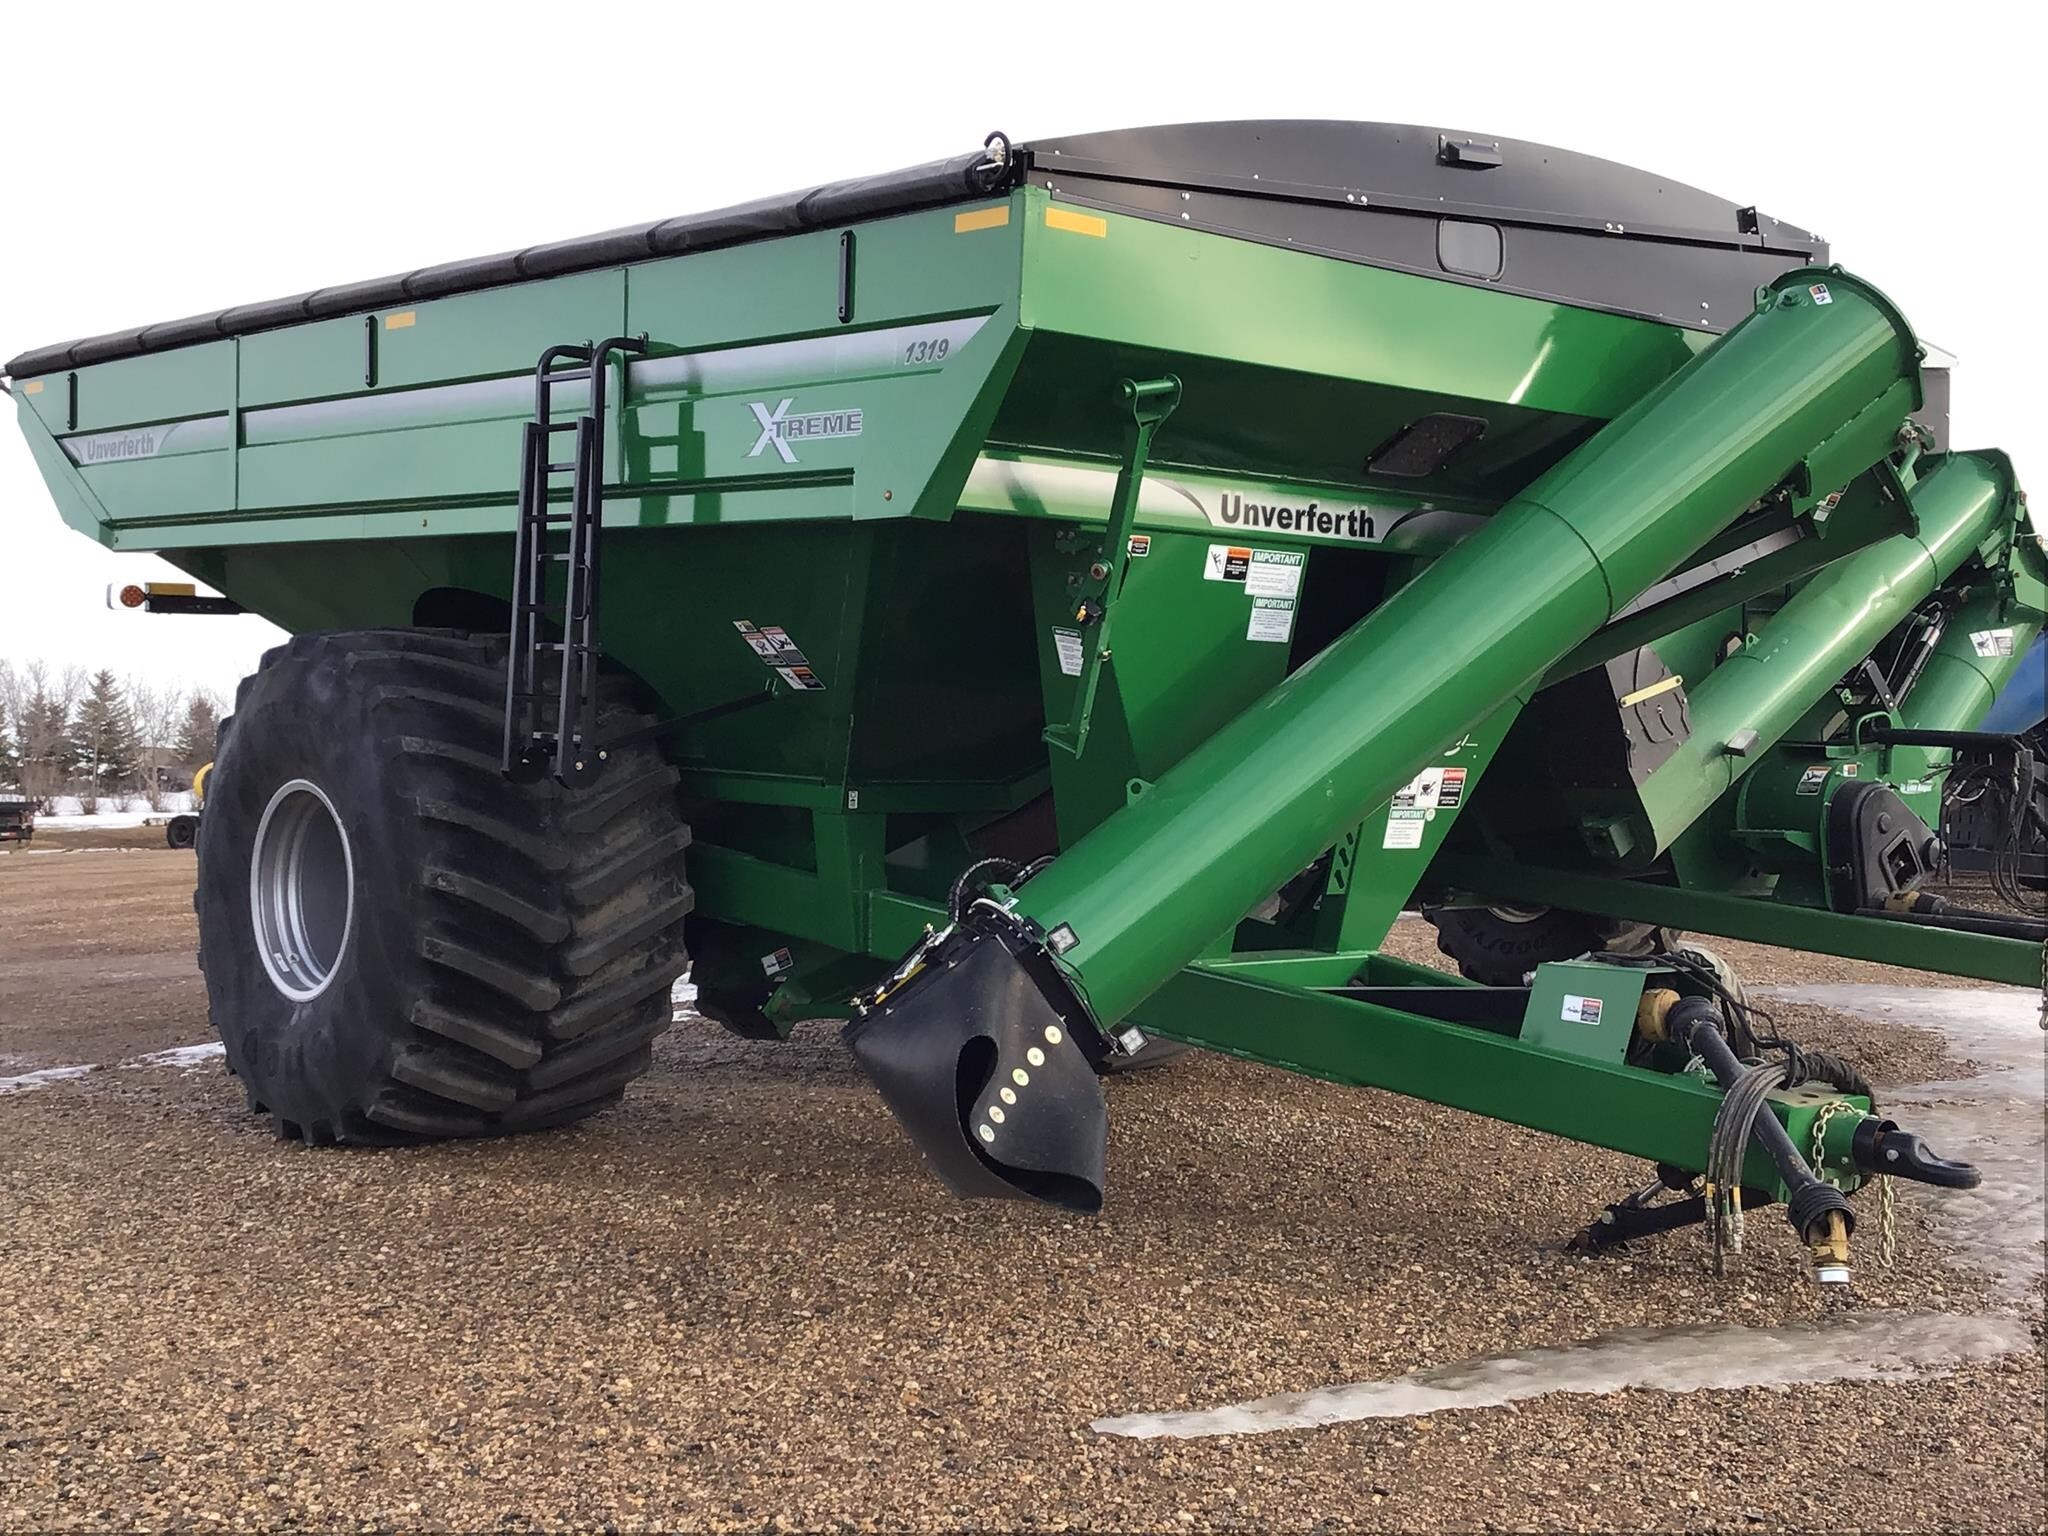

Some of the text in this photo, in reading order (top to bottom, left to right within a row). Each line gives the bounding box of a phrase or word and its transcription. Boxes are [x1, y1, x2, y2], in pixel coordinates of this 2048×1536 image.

[904, 338, 950, 363] 1319
[87, 433, 154, 460] Unverferth
[1221, 494, 1375, 538] Unverferth
[1253, 551, 1301, 565] IMPORTANT
[1255, 598, 1294, 609] IMPORTANT
